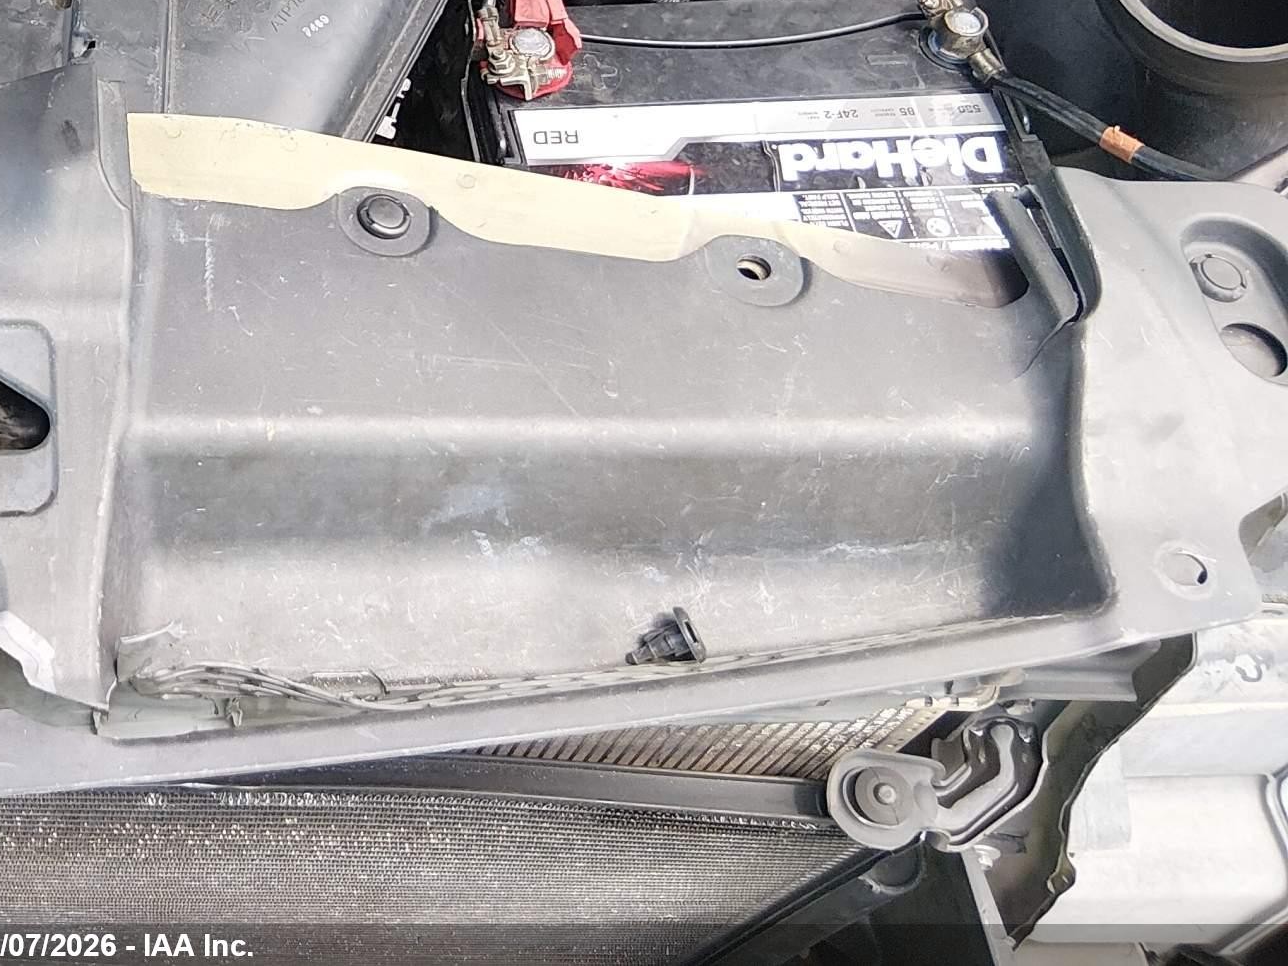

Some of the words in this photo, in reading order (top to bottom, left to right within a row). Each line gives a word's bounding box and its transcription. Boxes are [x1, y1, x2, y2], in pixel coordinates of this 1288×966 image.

[822, 108, 860, 120] 24F-2
[532, 129, 580, 145] RED
[777, 135, 1005, 183] DieHard
